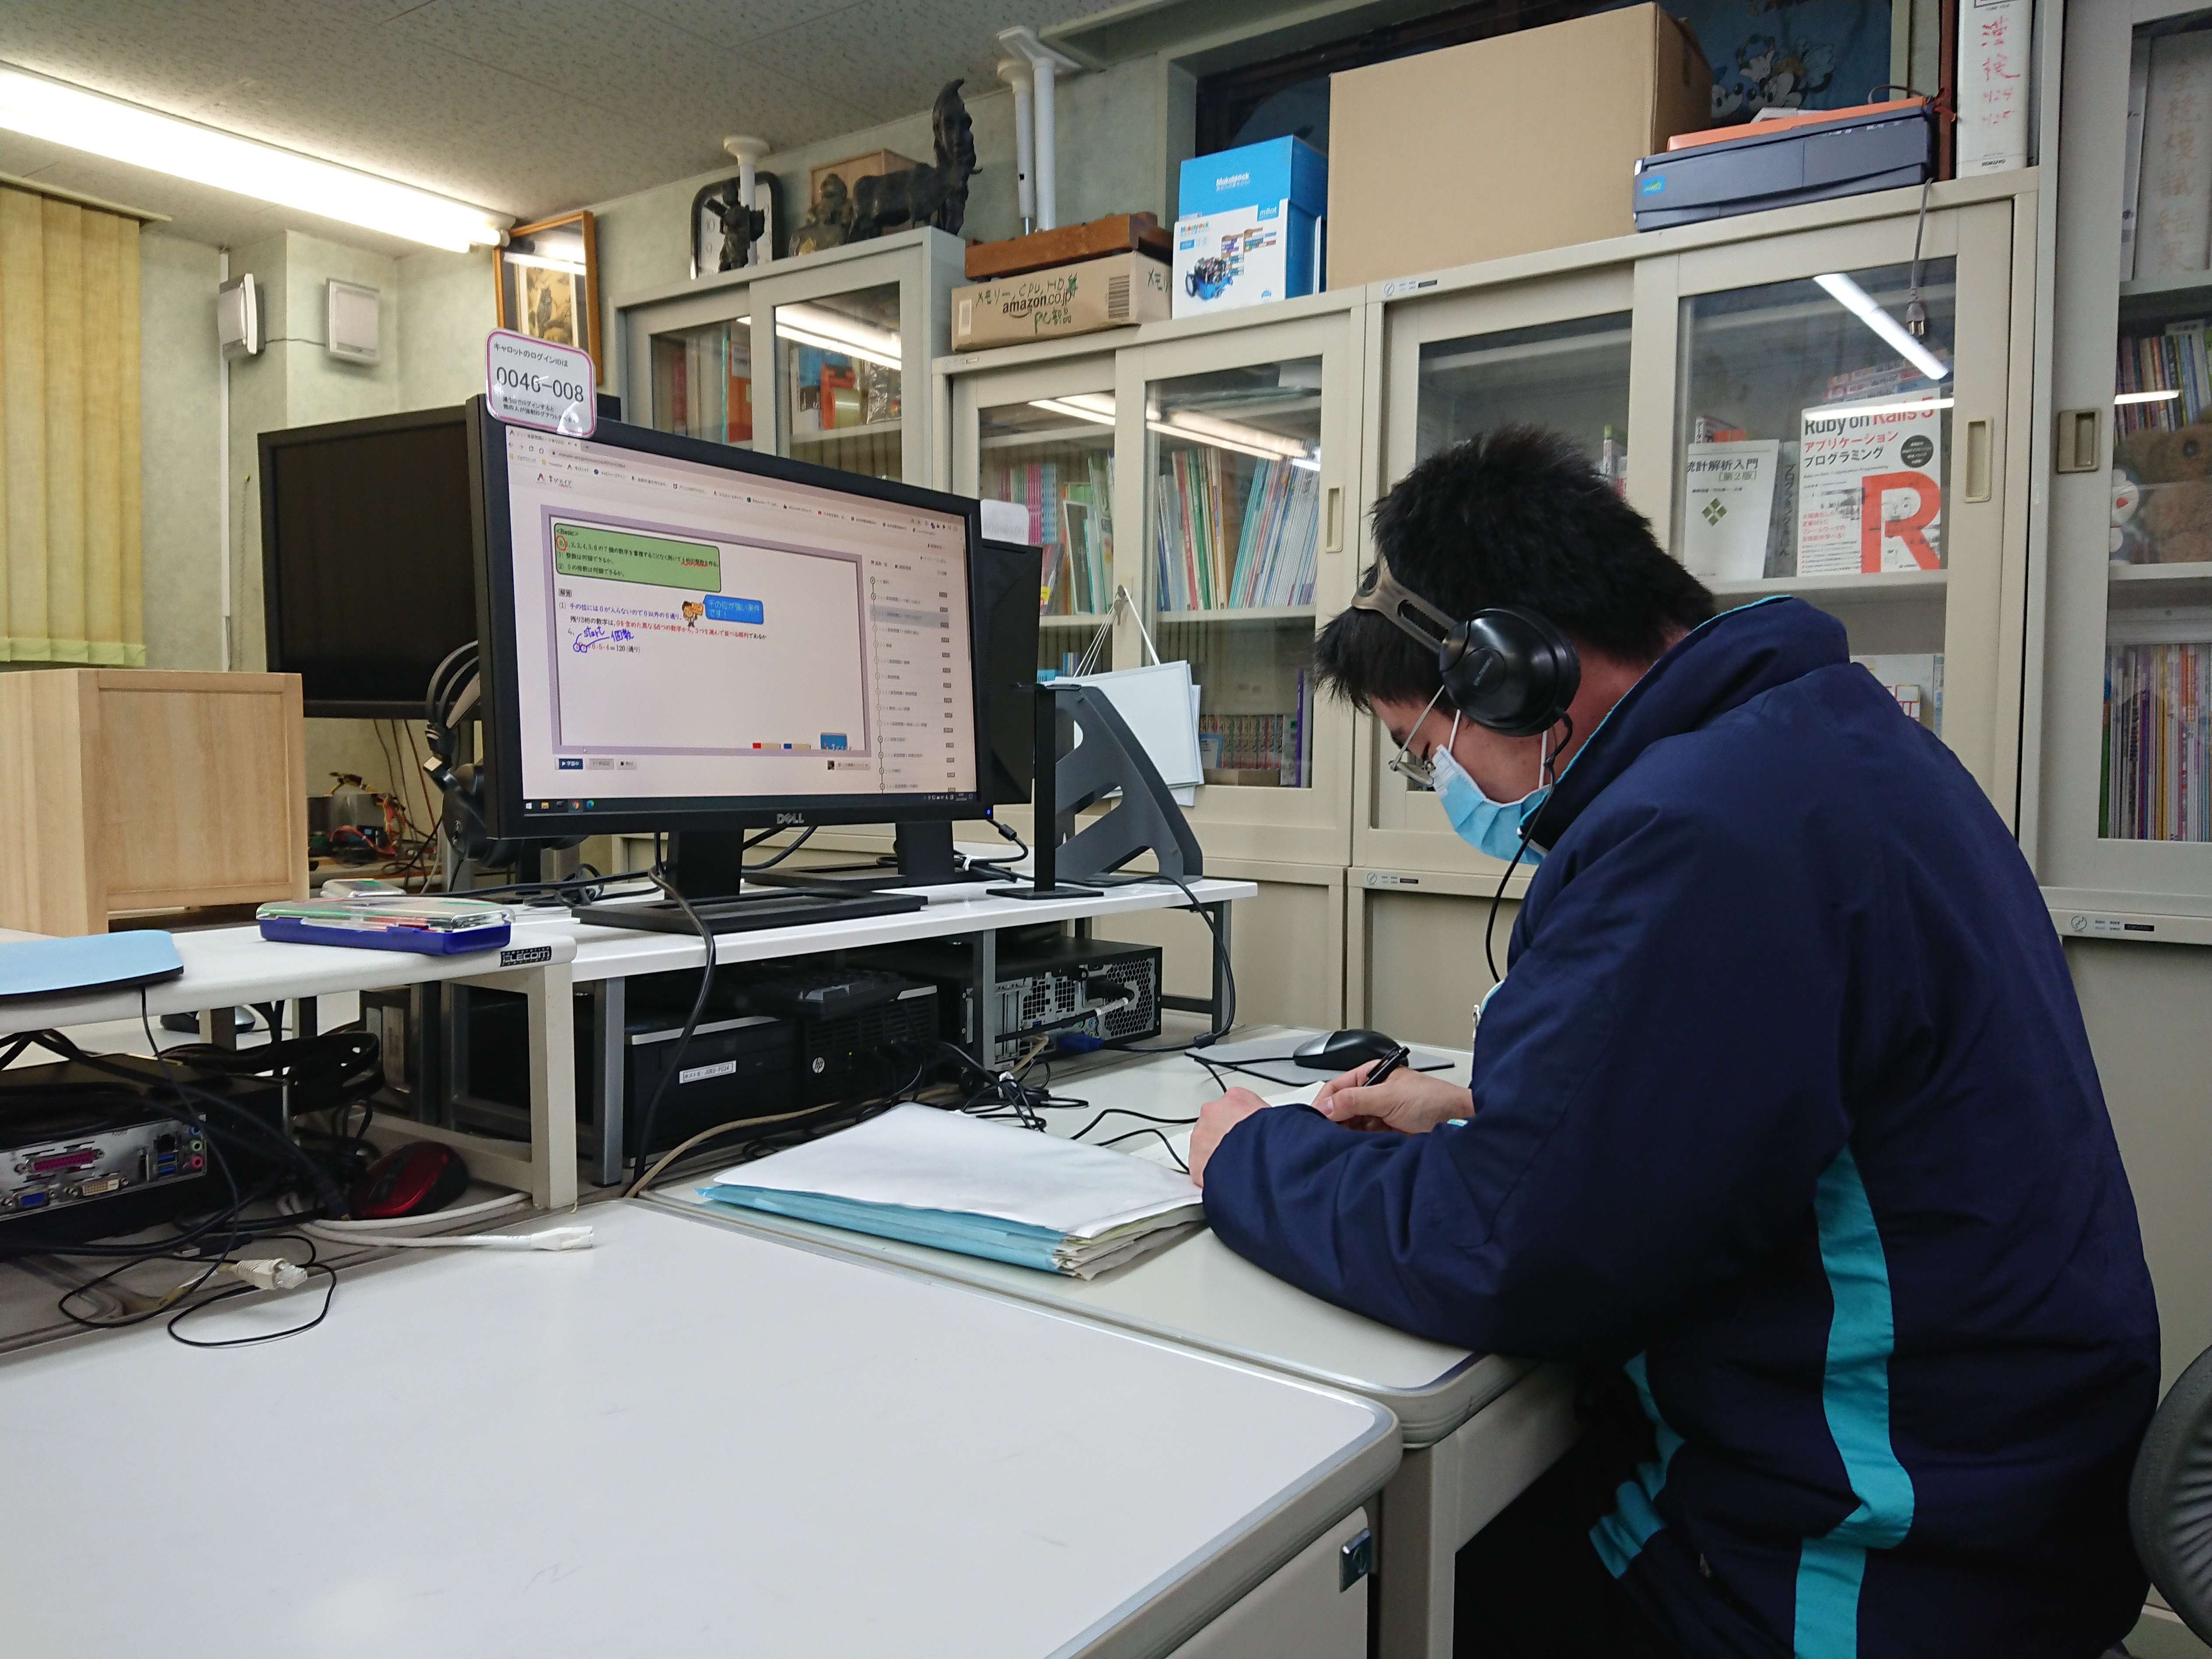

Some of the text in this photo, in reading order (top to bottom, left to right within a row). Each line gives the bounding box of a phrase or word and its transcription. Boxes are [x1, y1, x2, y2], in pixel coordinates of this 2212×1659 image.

[1002, 288, 1072, 315] amazon.co.jp
[494, 342, 568, 368] キャロットのログインIDは
[497, 367, 584, 402] 0046-008
[1805, 431, 1898, 449] アプリケーション
[1804, 442, 1884, 468] プログラミング
[777, 812, 805, 825] DELL
[813, 1057, 825, 1073] hp
